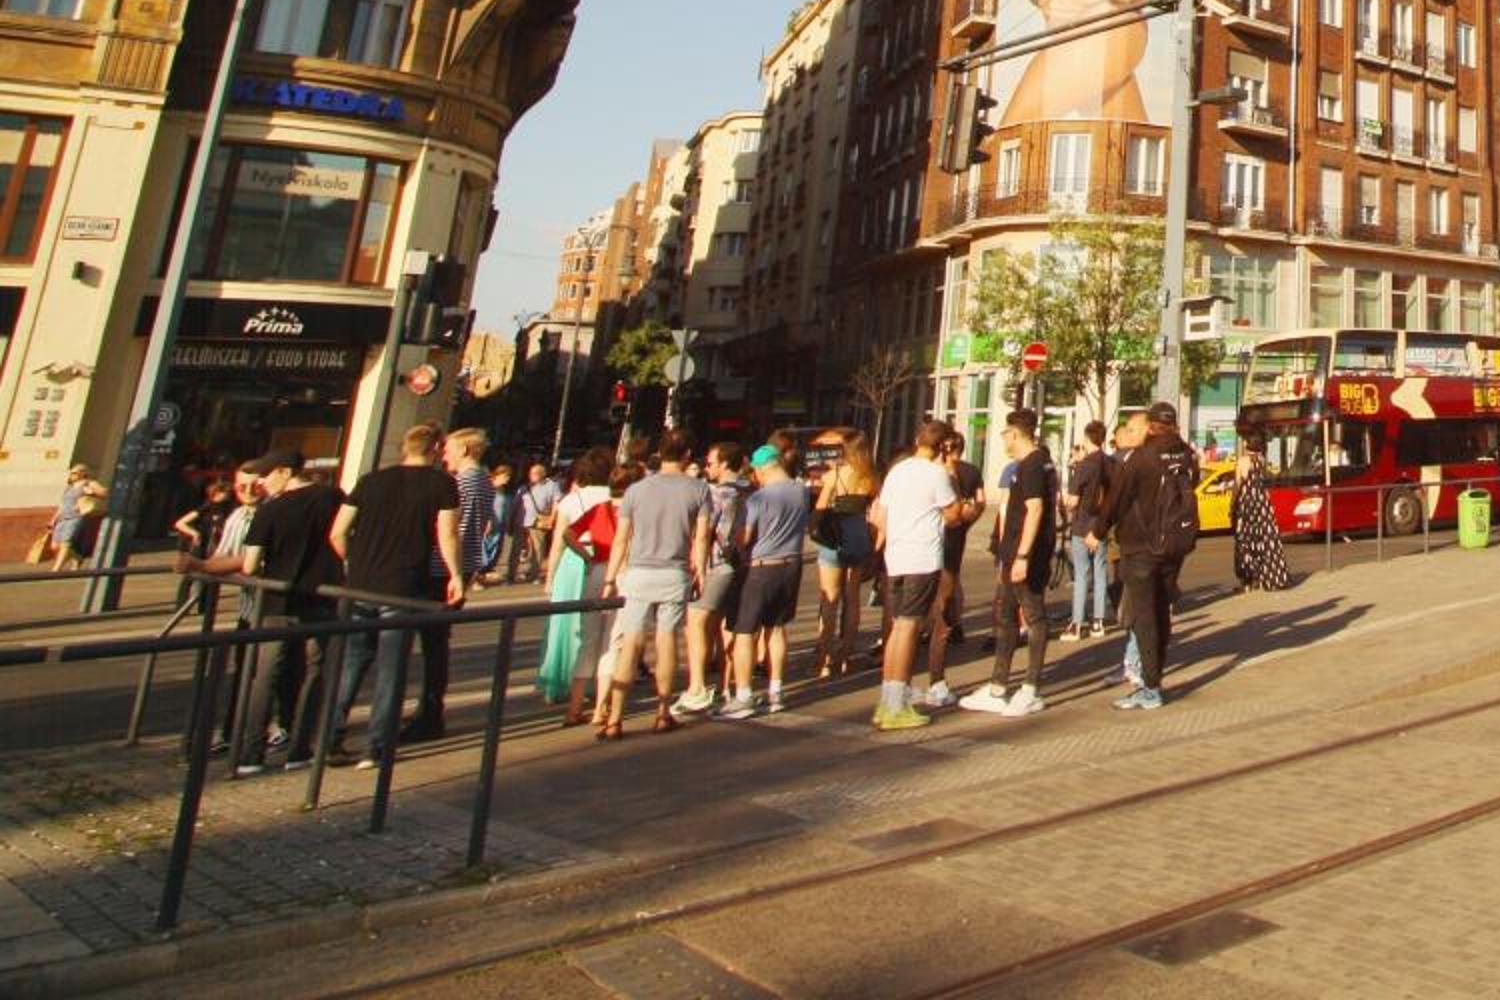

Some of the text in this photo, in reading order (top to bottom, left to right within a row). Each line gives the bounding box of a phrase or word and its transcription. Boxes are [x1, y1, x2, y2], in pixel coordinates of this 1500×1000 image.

[243, 316, 304, 335] Prima
[266, 349, 303, 368] FOOD
[1339, 384, 1362, 399] BIG
